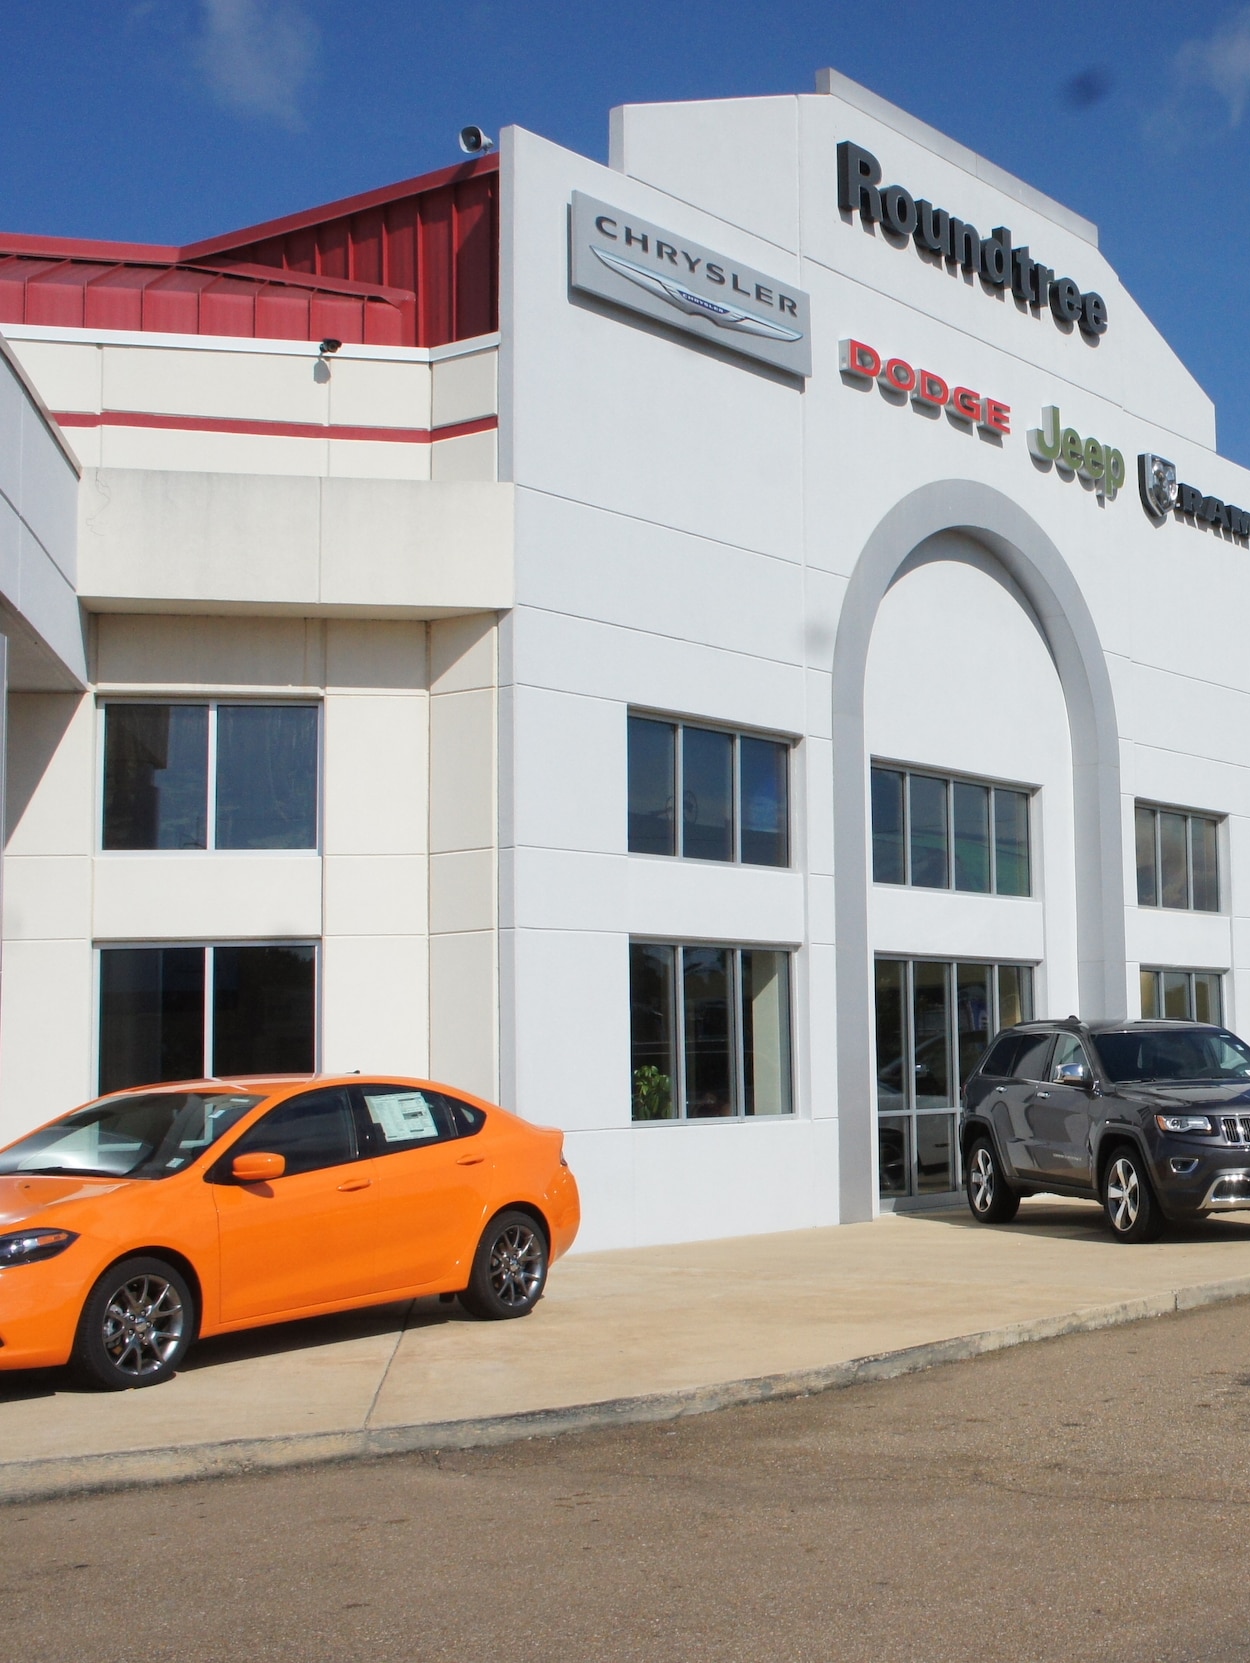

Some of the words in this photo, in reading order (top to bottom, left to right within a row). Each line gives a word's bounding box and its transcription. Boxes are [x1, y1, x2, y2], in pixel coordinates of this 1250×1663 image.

[595, 215, 798, 318] CHRYSLER
[836, 140, 1108, 336] Roundtree
[682, 292, 725, 313] CHRYSLER
[838, 339, 1011, 435] DODGE
[1027, 405, 1126, 497] Jeep
